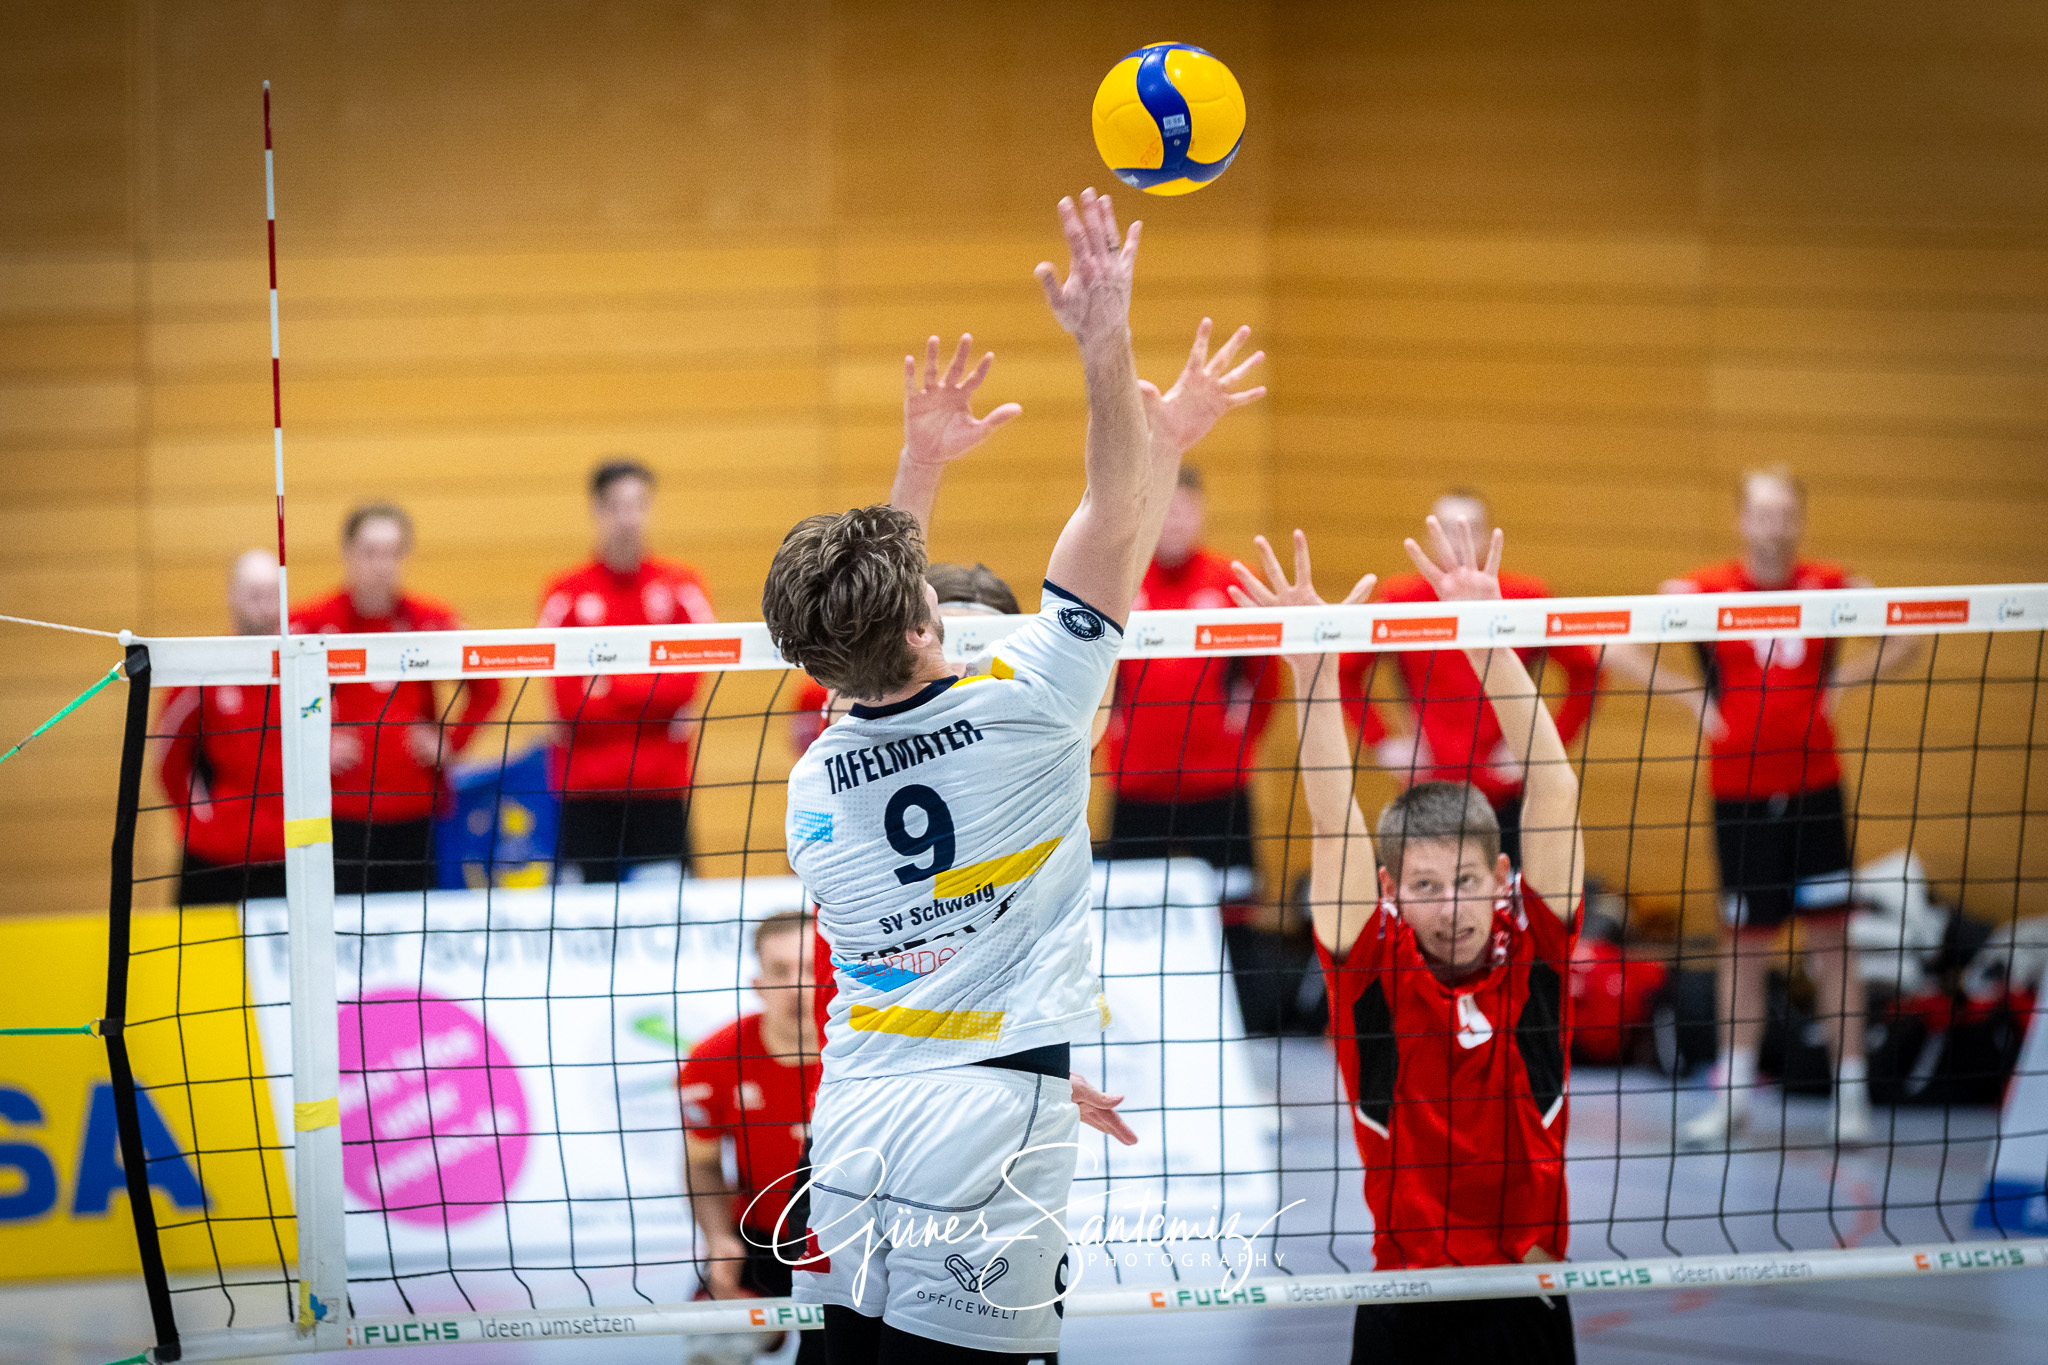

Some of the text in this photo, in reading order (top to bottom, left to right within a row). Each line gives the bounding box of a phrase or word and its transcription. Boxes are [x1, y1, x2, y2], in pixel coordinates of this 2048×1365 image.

[884, 784, 956, 886] 9
[879, 912, 904, 935] SV
[910, 881, 996, 927] Schwaig
[1565, 1267, 1652, 1289] FUCHS
[917, 1290, 1018, 1321] OFFICEWELT
[1177, 1285, 1267, 1307] FUCHS
[364, 1314, 637, 1345] FUCHS Ideen umsetzen
